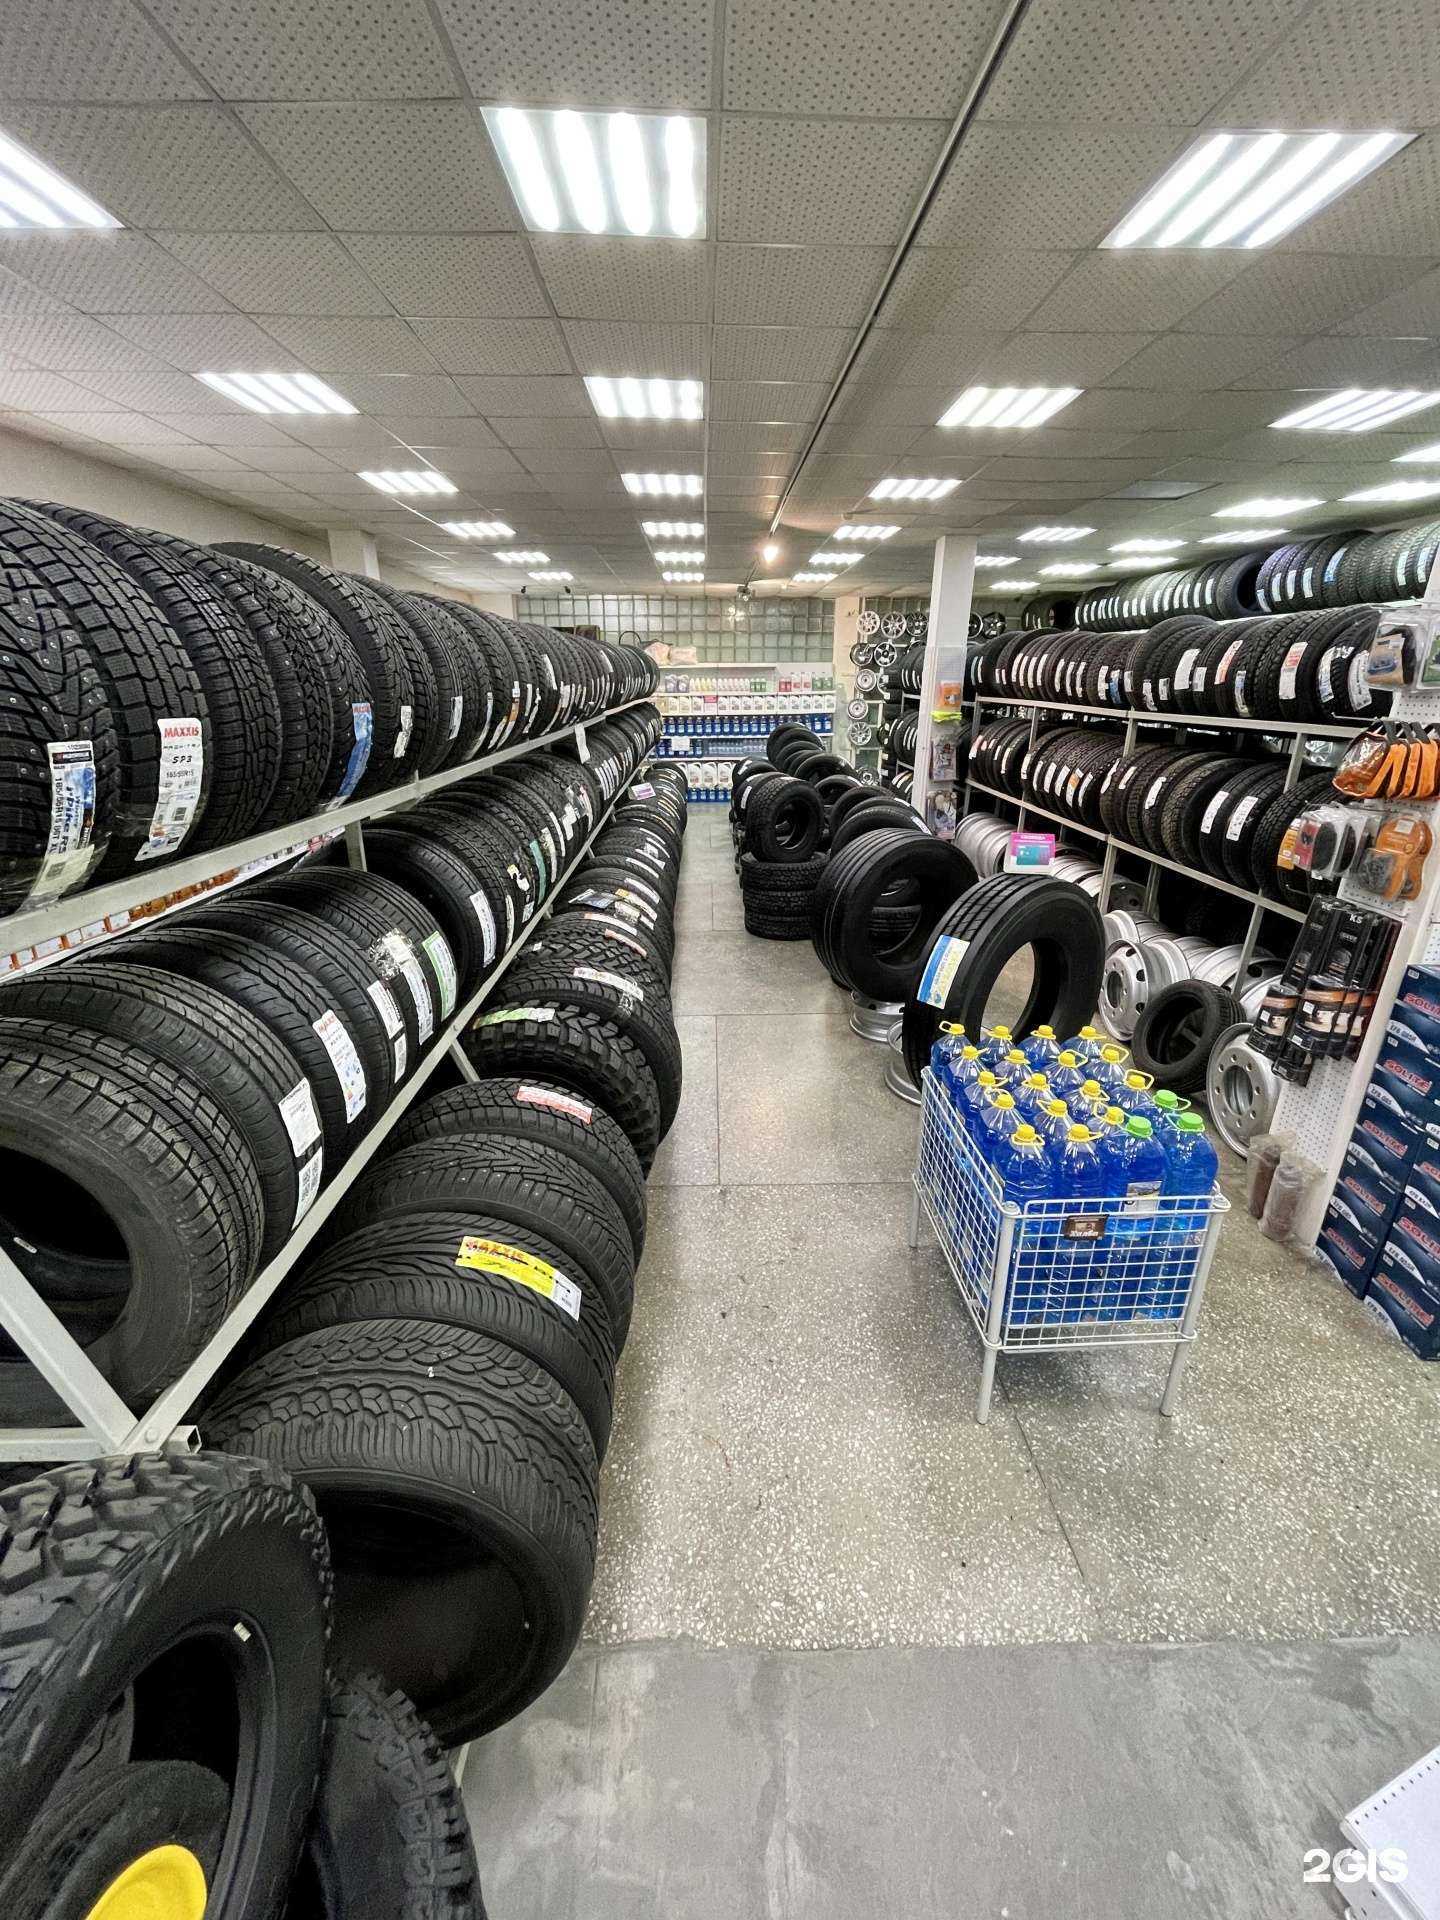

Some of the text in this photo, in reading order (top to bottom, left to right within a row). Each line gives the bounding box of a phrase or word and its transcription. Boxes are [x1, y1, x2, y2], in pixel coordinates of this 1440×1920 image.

[164, 726, 199, 738] MAXXIS
[172, 755, 192, 764] SP3
[1384, 1060, 1432, 1095] SOLITE
